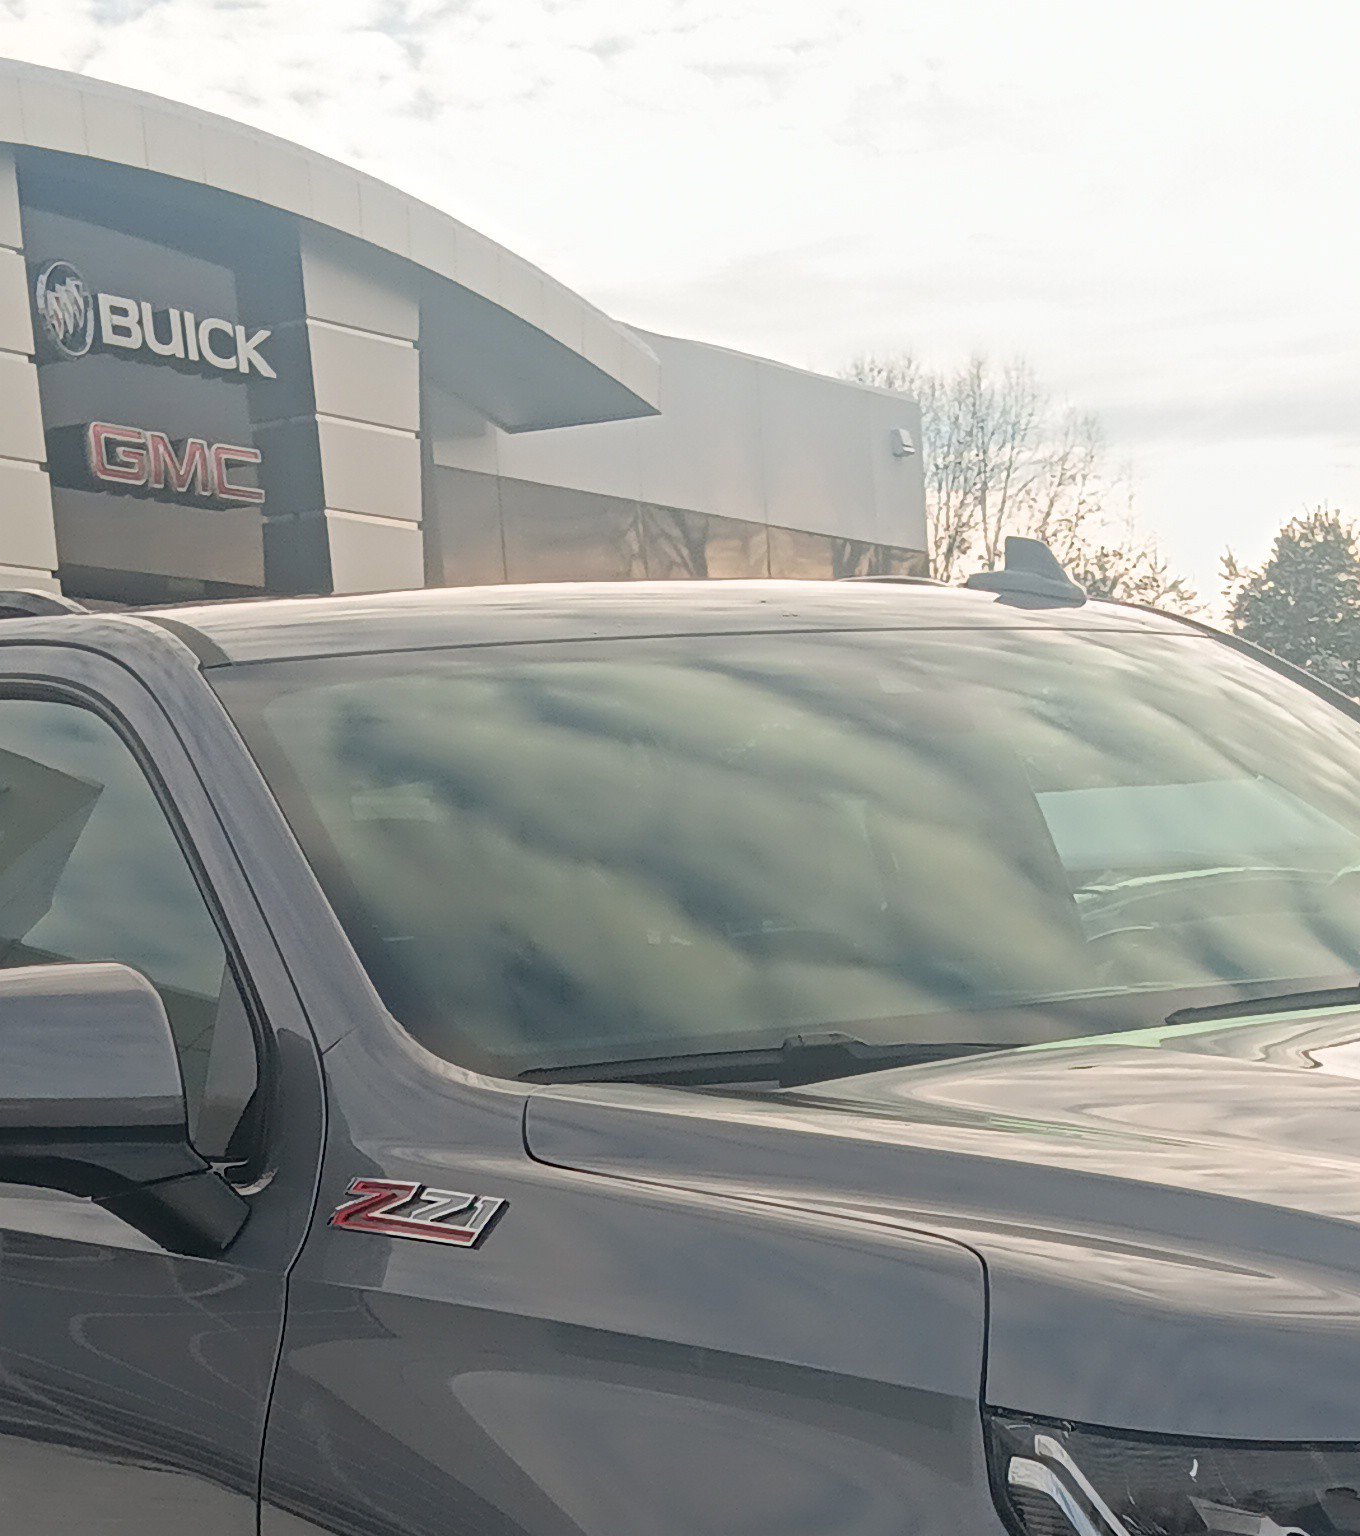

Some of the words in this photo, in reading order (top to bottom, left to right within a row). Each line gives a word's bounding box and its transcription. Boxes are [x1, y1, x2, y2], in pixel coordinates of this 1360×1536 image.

[97, 292, 277, 379] BUICK
[89, 421, 265, 504] GMC
[330, 1176, 508, 1249] Z71
